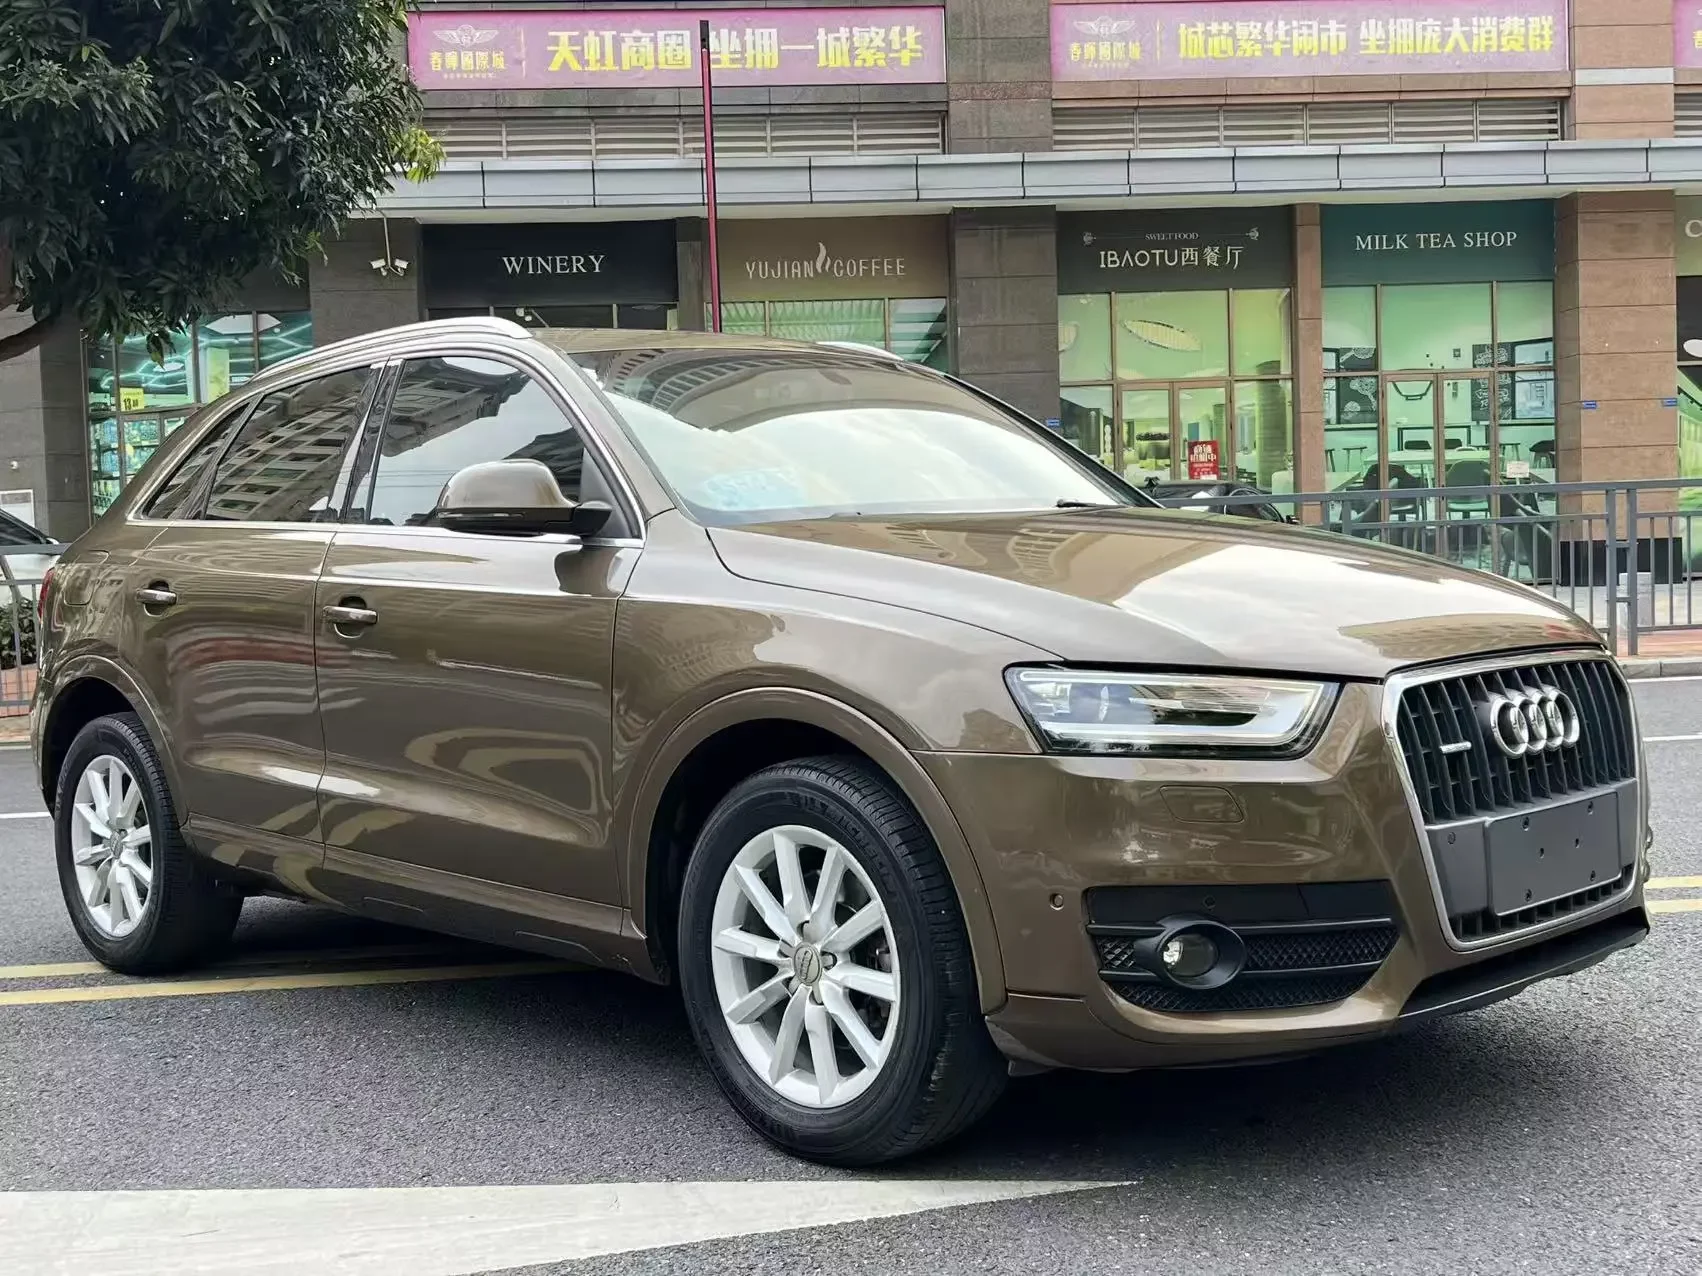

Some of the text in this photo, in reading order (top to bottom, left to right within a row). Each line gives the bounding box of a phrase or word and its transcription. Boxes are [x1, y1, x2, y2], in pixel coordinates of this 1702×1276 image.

[547, 25, 923, 71] 天虹商圈 坐拥一城繁华
[1174, 232, 1199, 240] FOOD
[1355, 231, 1517, 250] MILK TEA SHOP
[502, 255, 605, 274] WINERY
[746, 258, 906, 280] YUJIAN COFFEE
